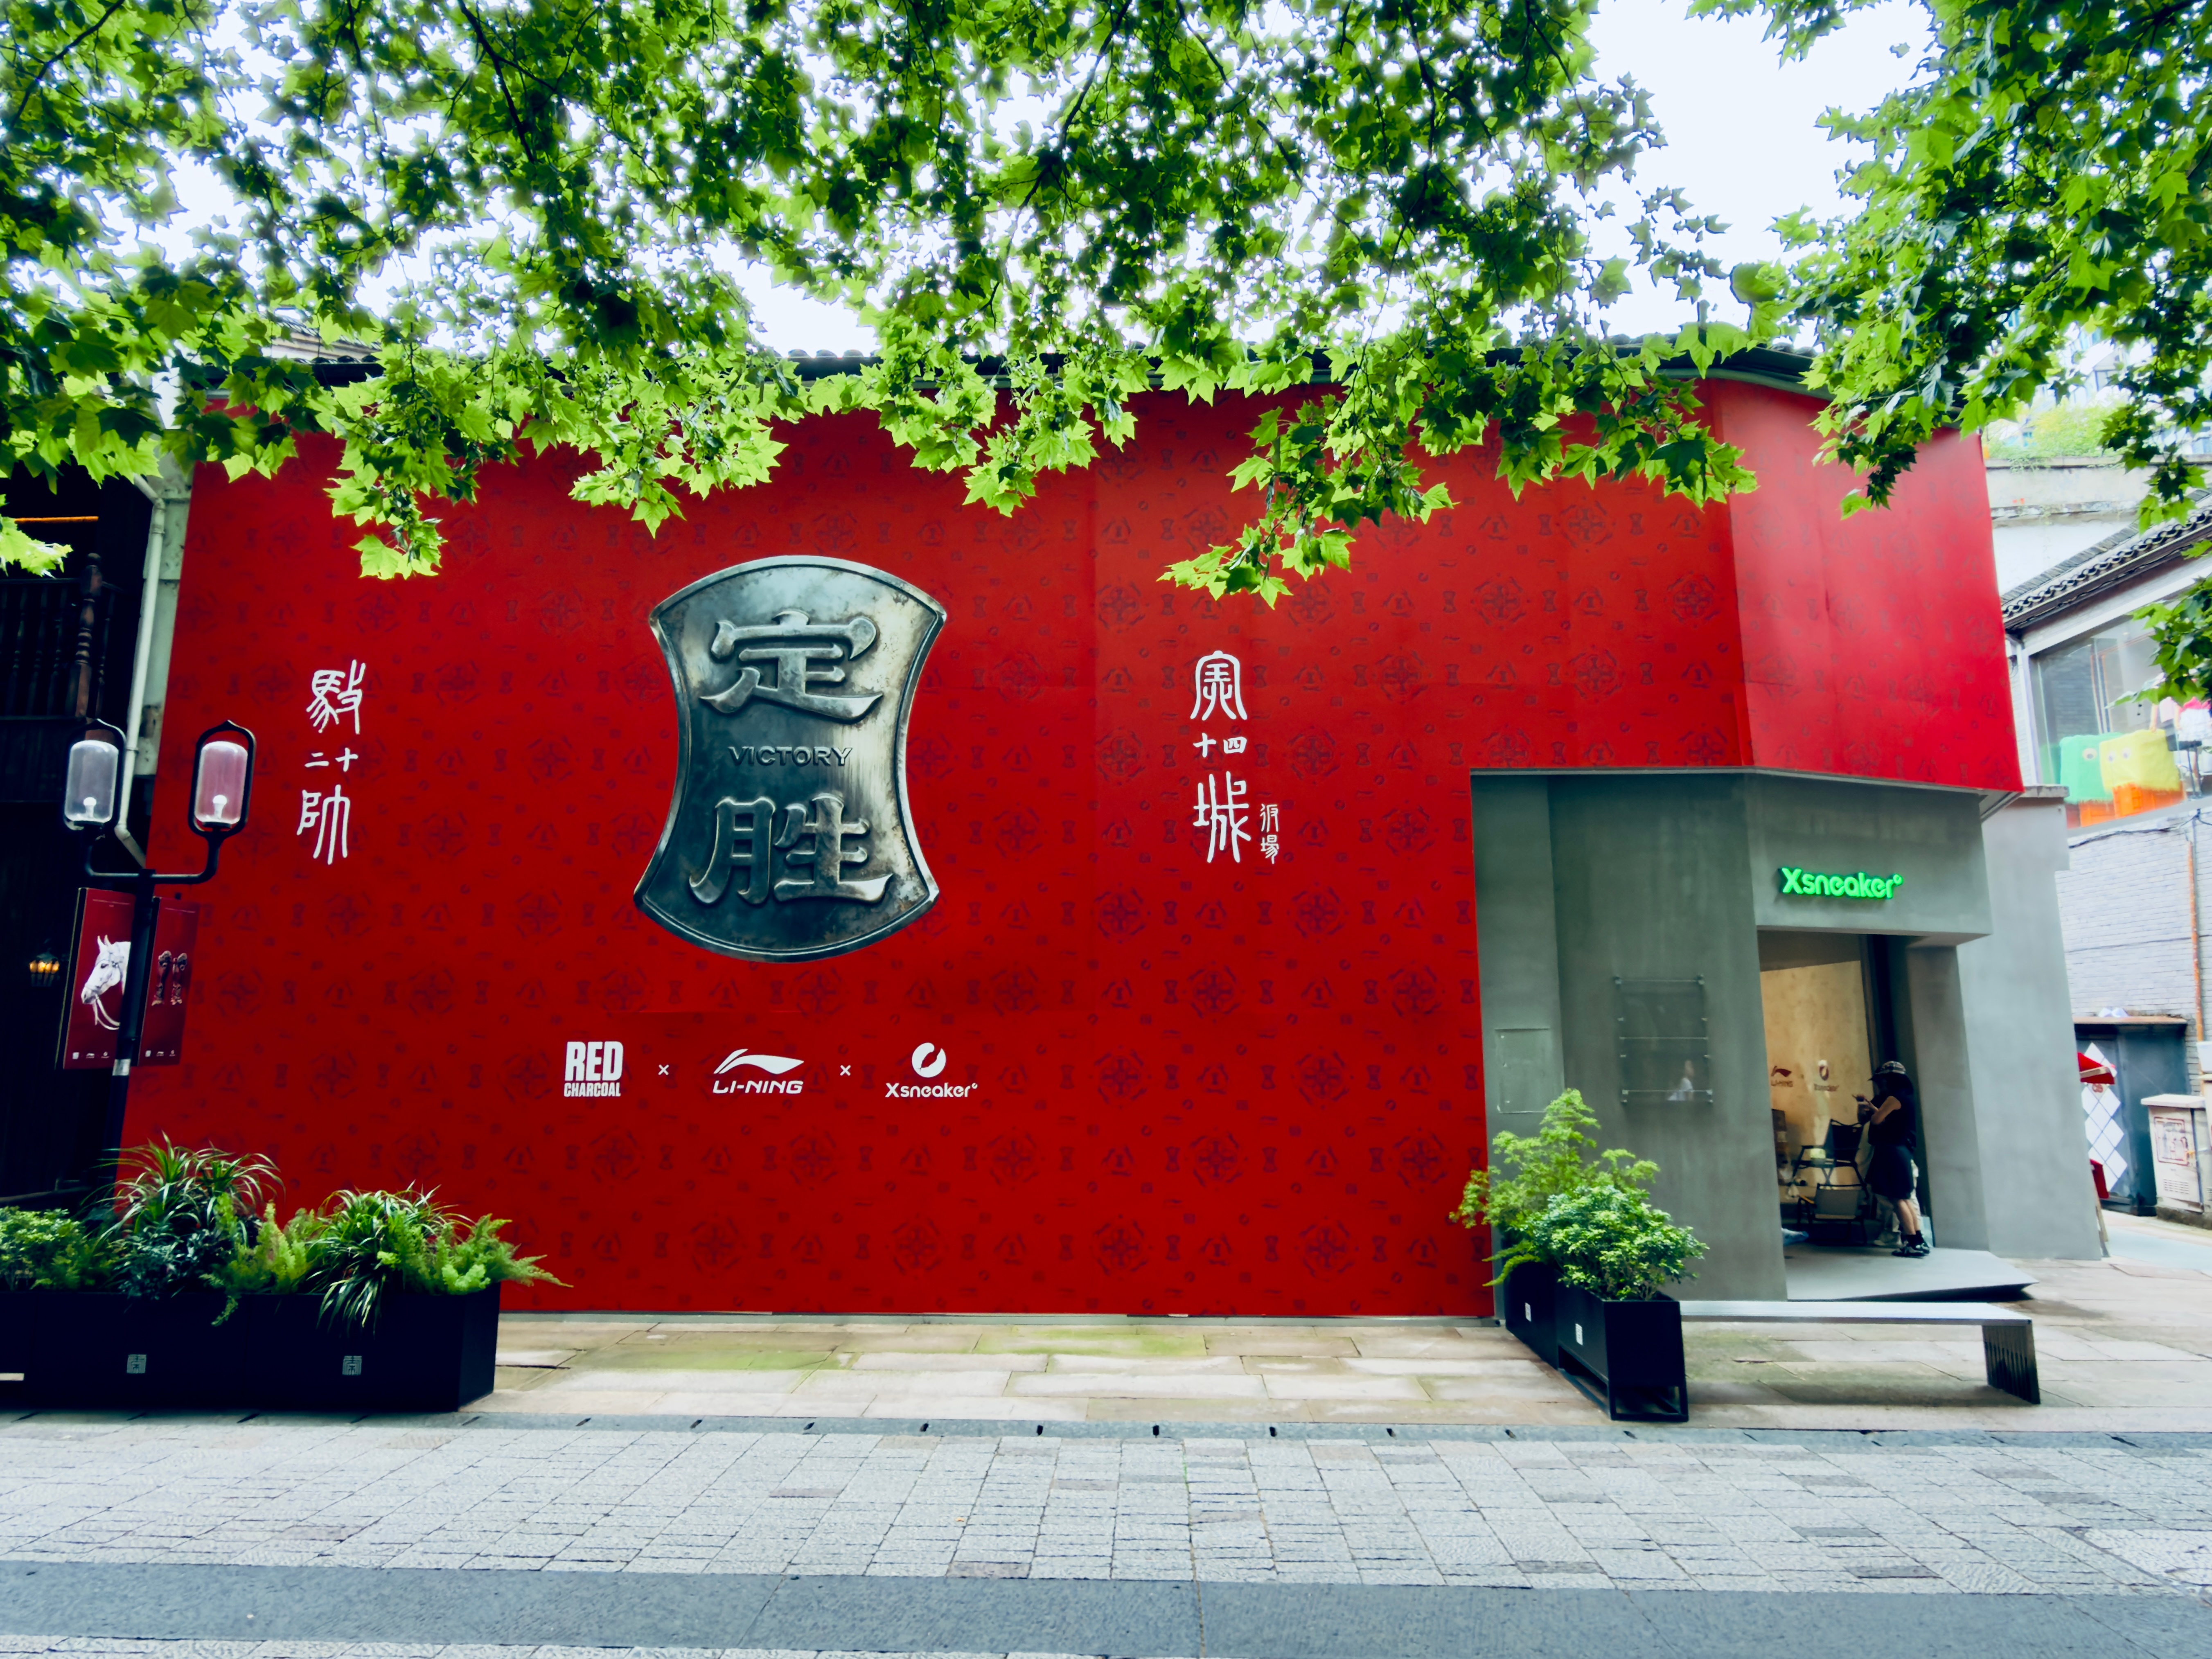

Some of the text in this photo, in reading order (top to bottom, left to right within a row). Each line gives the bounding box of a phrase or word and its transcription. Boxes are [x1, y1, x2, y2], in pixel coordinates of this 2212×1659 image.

[698, 609, 884, 724] 定
[728, 745, 853, 768] VICTORY
[688, 792, 894, 906] 胜
[564, 1041, 624, 1082] RED
[563, 1082, 621, 1098] CHARCOAL
[713, 1080, 804, 1094] LI-NING
